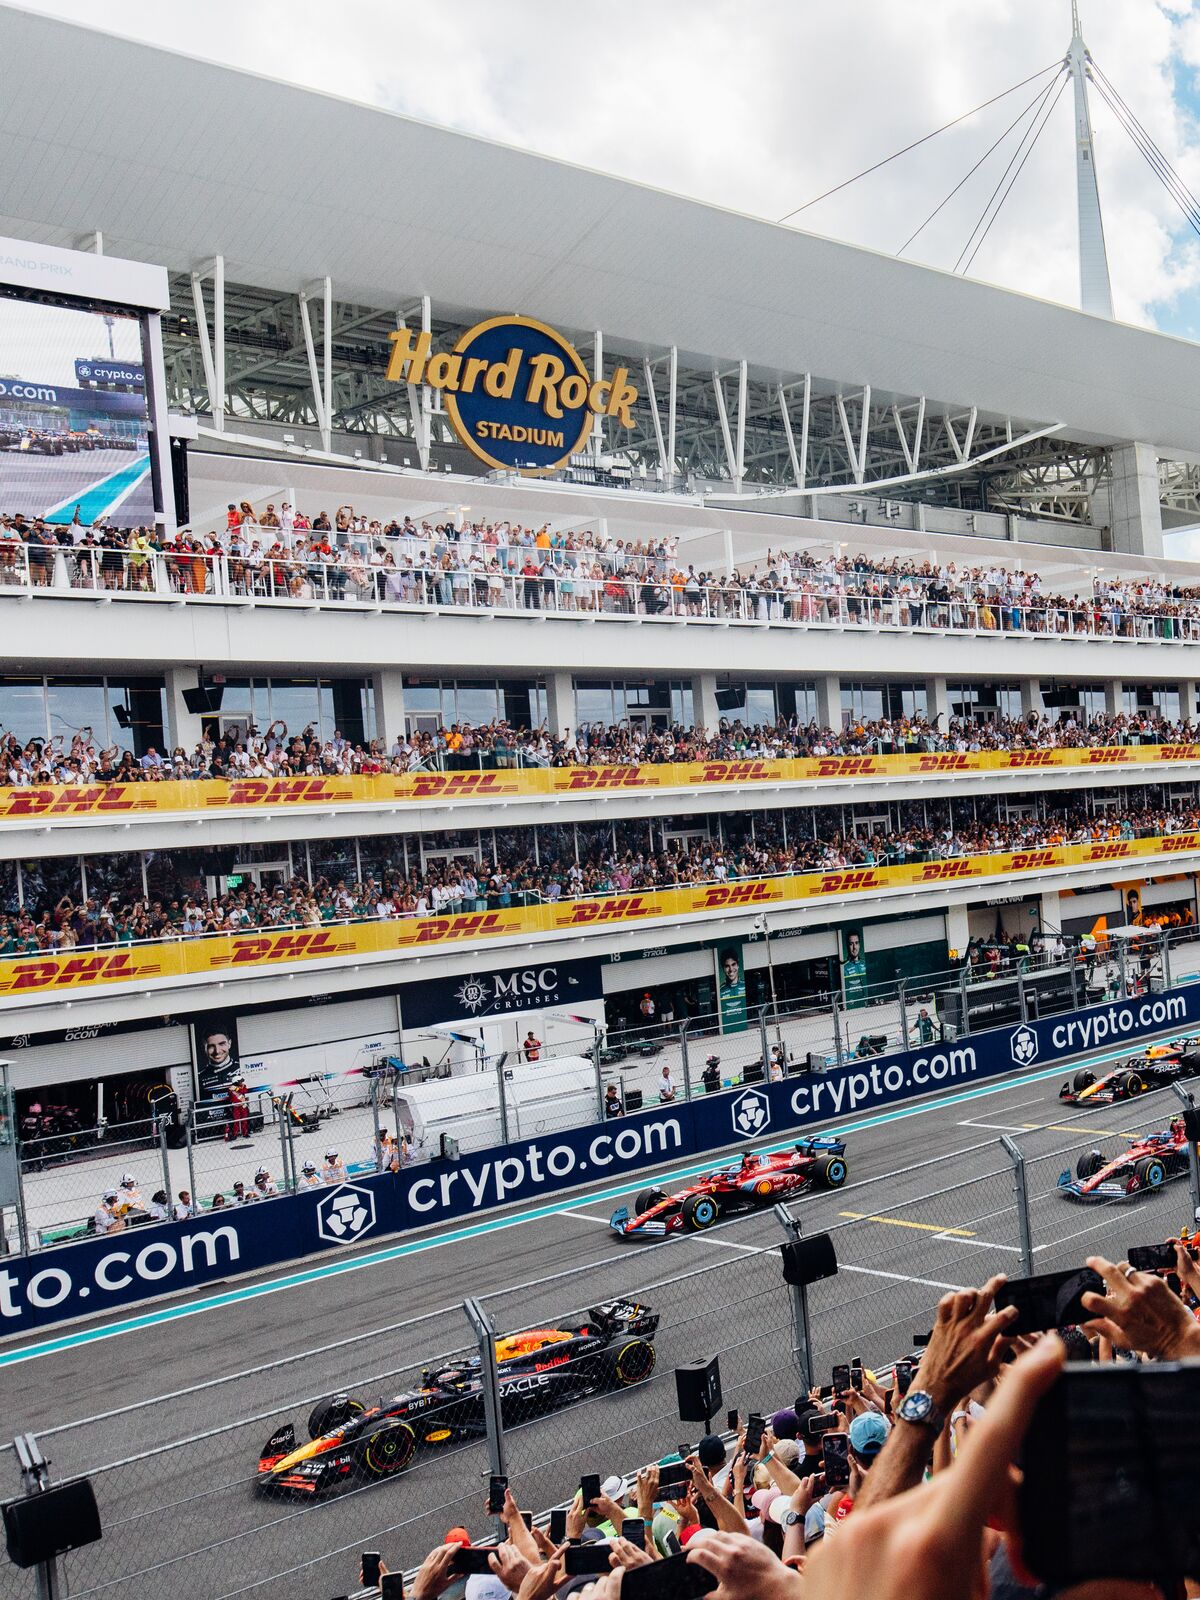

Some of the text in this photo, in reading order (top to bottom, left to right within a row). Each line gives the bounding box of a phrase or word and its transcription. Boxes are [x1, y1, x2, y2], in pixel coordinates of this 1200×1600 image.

[384, 328, 639, 430] Hard Rock
[476, 420, 564, 447] STADIUM
[1008, 752, 1054, 767] DHL
[1088, 749, 1129, 763] DHL
[1160, 746, 1197, 759] DHL
[703, 762, 769, 782] DHL
[816, 759, 876, 776] DHL
[919, 755, 970, 770] DHL
[412, 774, 501, 796] DHL
[569, 768, 645, 789] DHL
[6, 788, 133, 814] DHL
[229, 780, 333, 804] DHL
[1088, 843, 1131, 860] DHL
[1162, 836, 1197, 851] DHL
[920, 860, 974, 880] DHL
[1011, 851, 1056, 870] DHL
[819, 871, 878, 892] DHL
[703, 882, 771, 908] DHL
[572, 898, 647, 923] DHL
[416, 914, 504, 942] DHL
[748, 932, 759, 942] 14
[777, 929, 802, 938] ALONSO
[232, 932, 336, 963] DHL
[610, 952, 621, 962] 18
[642, 948, 668, 958] STROLL
[12, 954, 137, 989] DHL
[493, 968, 558, 998] MSC
[494, 993, 560, 1010] CRUISES
[1053, 997, 1187, 1048] crypto.com
[65, 1029, 98, 1041] OCON
[792, 1047, 977, 1117] crypto.com
[408, 1118, 682, 1214] crypto.com
[578, 1339, 601, 1352] HONDA
[535, 1354, 571, 1373] Red Bull
[408, 1396, 433, 1411] BYBIT
[270, 1431, 293, 1446] Claro
